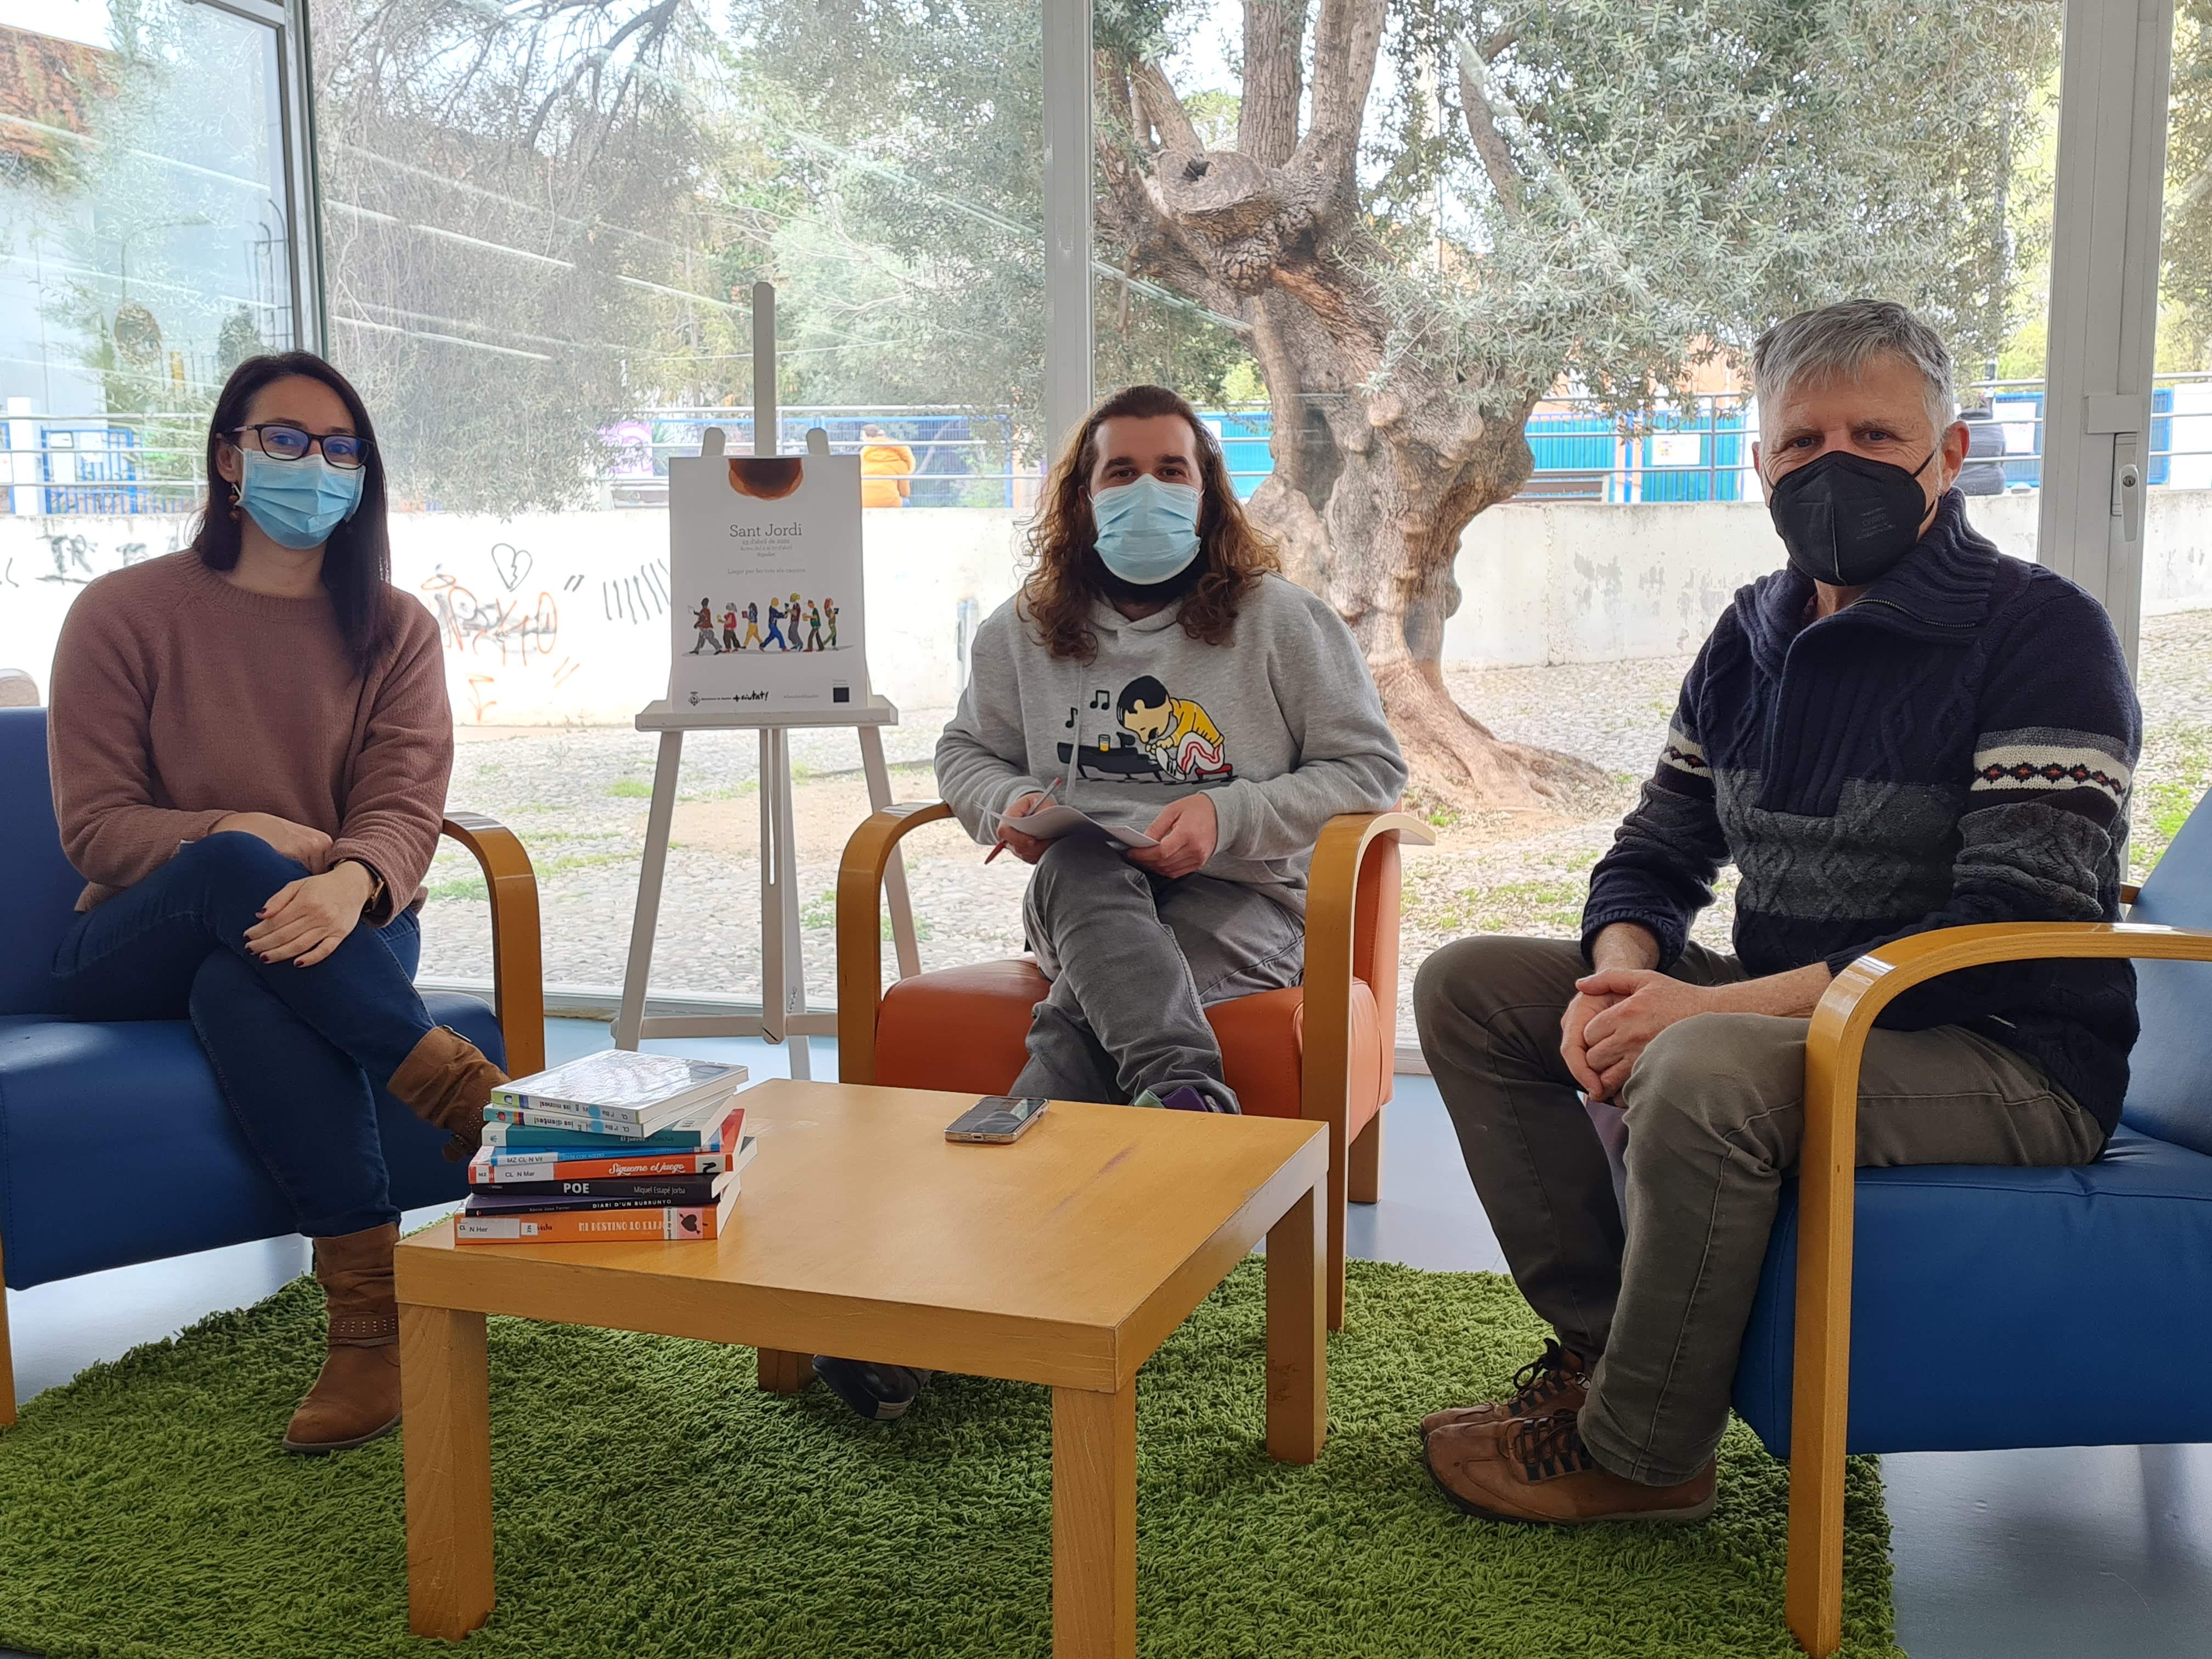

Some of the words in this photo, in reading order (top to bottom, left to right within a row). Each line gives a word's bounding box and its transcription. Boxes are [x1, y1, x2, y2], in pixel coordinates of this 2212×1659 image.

[730, 524, 761, 537] Sant
[765, 522, 802, 536] Jordi
[534, 1116, 562, 1126] dientes!
[651, 1163, 659, 1171] el
[658, 1163, 686, 1173] juego
[563, 1182, 590, 1194] POE
[634, 1186, 652, 1195] Miquel
[653, 1186, 671, 1195] Estapé
[579, 1222, 589, 1232] MI
[591, 1221, 627, 1231] DESTINO
[629, 1221, 640, 1231] LO
